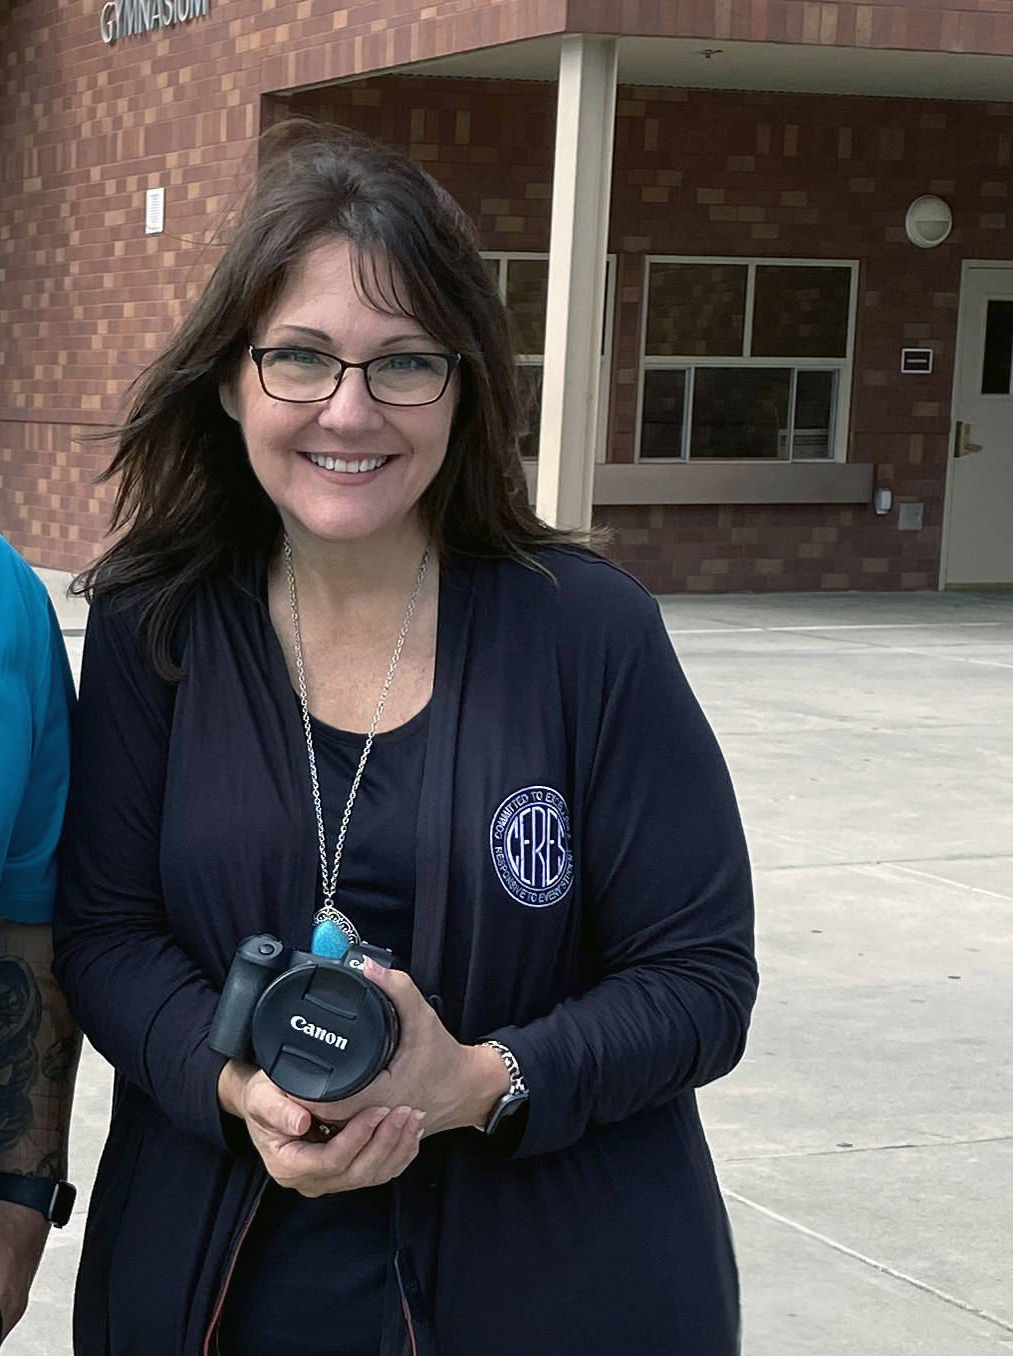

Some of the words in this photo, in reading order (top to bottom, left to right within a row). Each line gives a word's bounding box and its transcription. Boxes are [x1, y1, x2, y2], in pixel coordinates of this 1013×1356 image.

[530, 790, 544, 801] TO
[506, 805, 566, 888] CERES
[527, 891, 538, 902] TO
[290, 1015, 349, 1050] Canon
